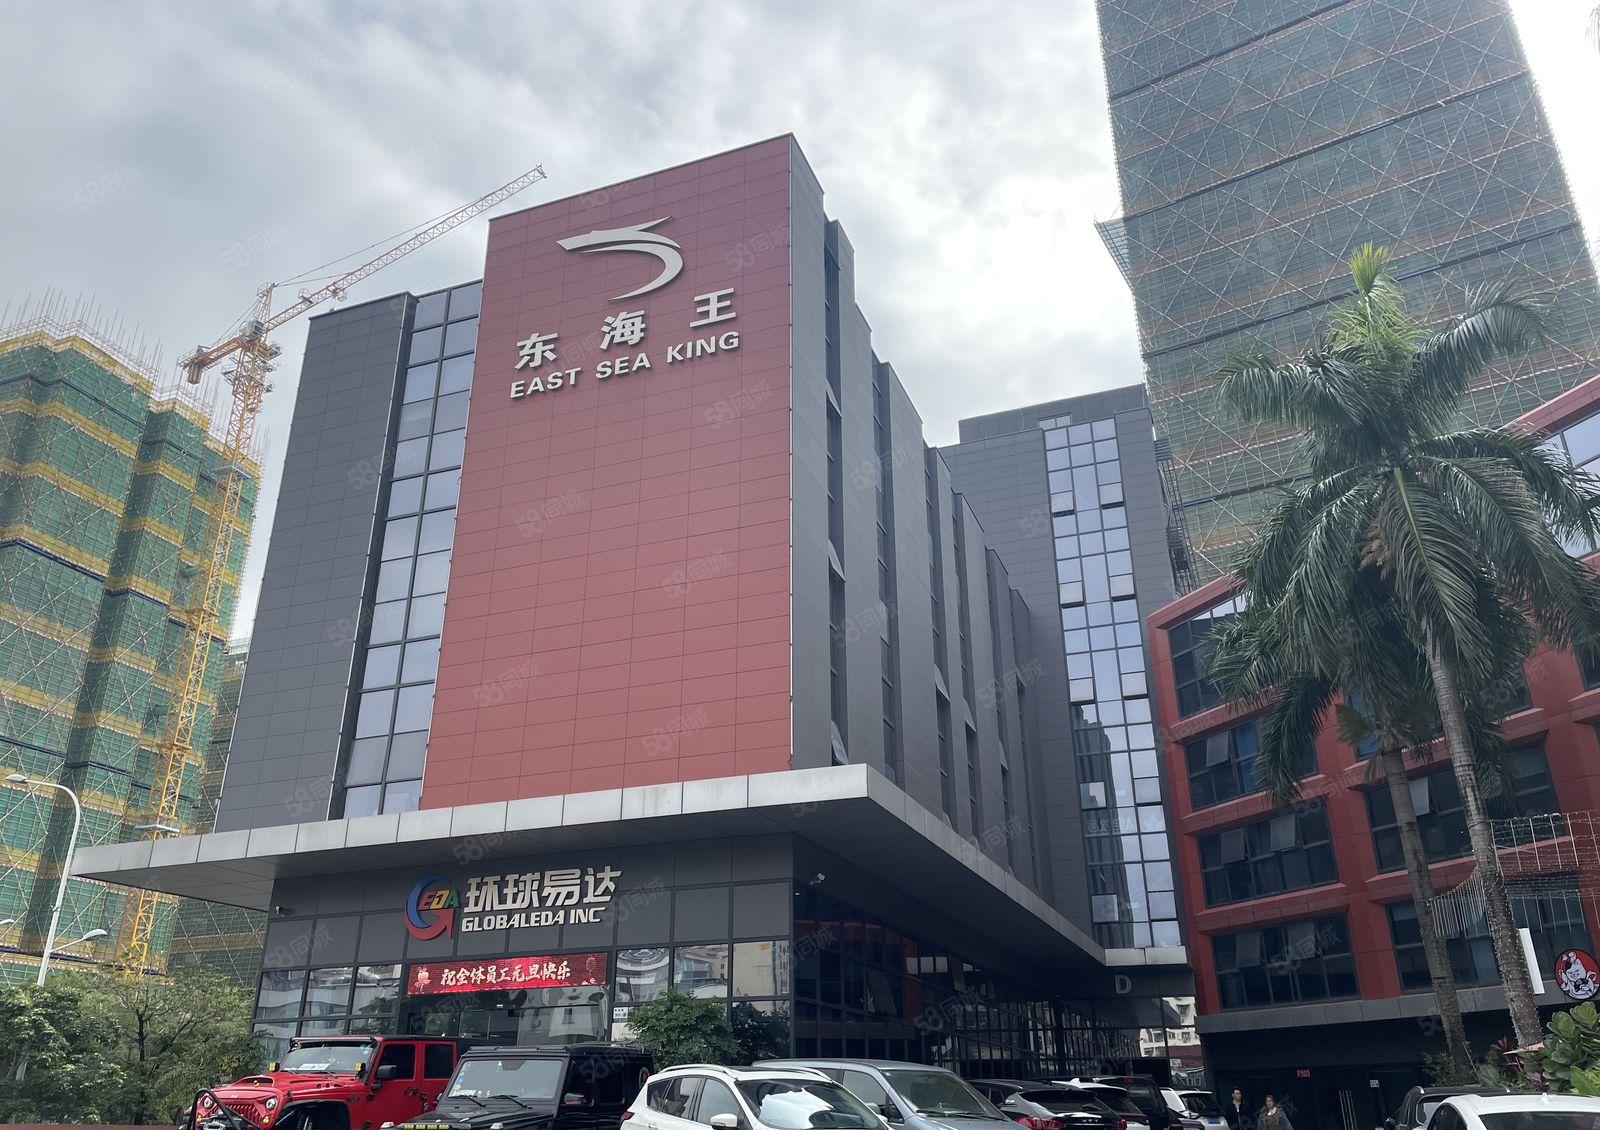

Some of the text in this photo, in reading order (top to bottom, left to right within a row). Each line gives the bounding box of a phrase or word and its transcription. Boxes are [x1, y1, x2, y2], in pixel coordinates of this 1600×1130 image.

[514, 287, 737, 370] 东海王
[510, 331, 740, 399] EAST SEA KING
[463, 865, 622, 914] 环球易达
[461, 907, 606, 932] GLOBALEDA INC
[440, 960, 571, 986] 祝全体员工元旦快乐
[1115, 975, 1133, 995] D
